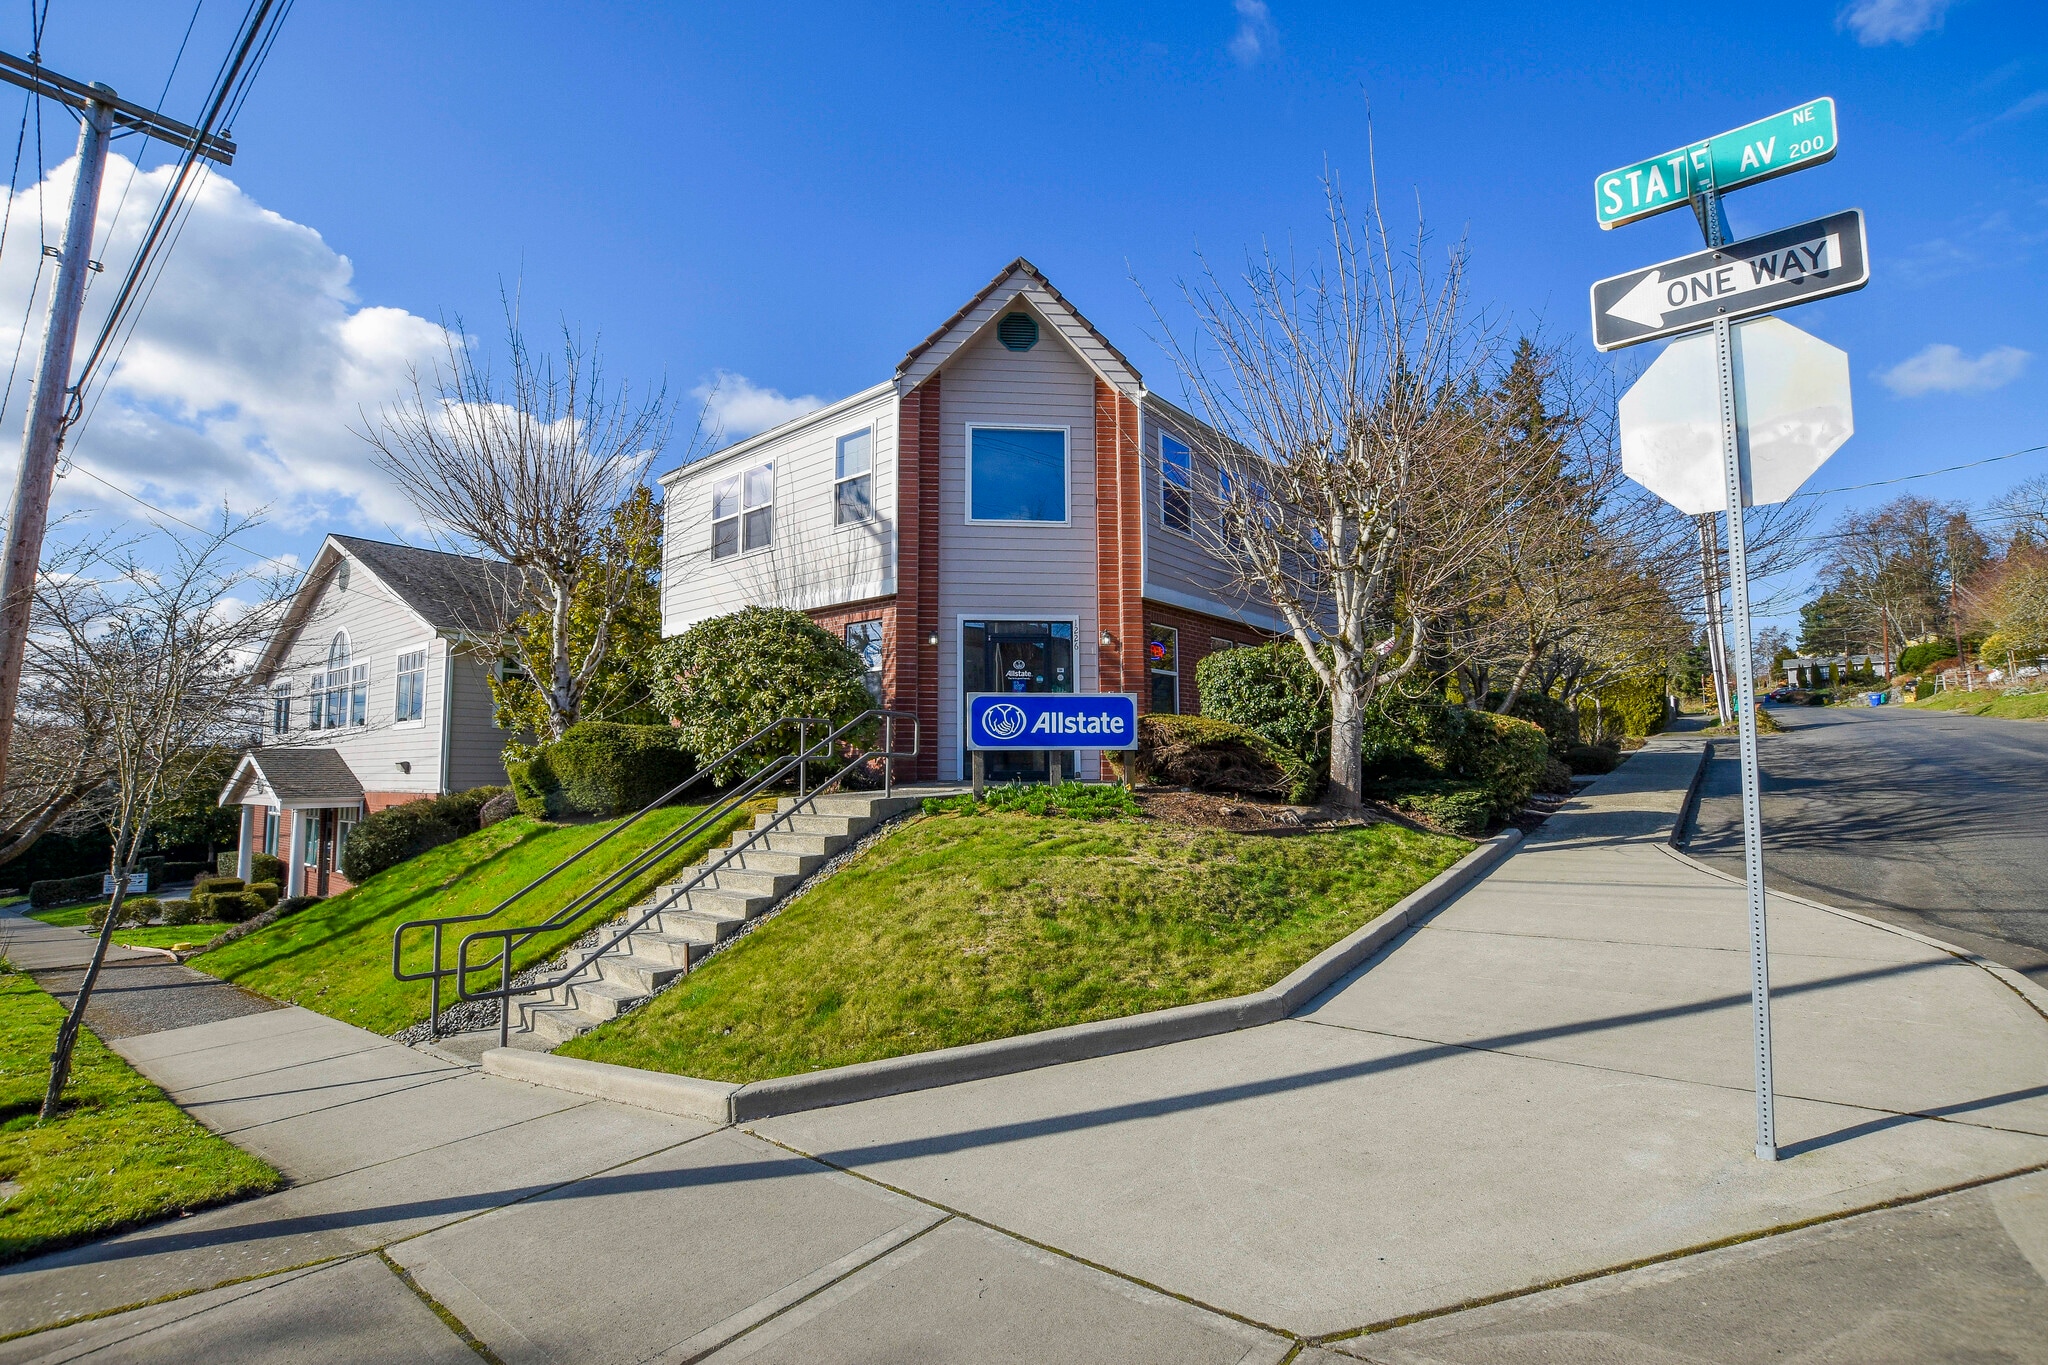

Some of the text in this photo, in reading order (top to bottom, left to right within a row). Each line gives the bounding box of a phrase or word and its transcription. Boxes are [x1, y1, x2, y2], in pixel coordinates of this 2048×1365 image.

[1792, 106, 1815, 126] NE
[1603, 135, 1824, 214] STATE AV 200
[1667, 240, 1827, 307] ONE WAY
[1030, 712, 1124, 734] Allstate
